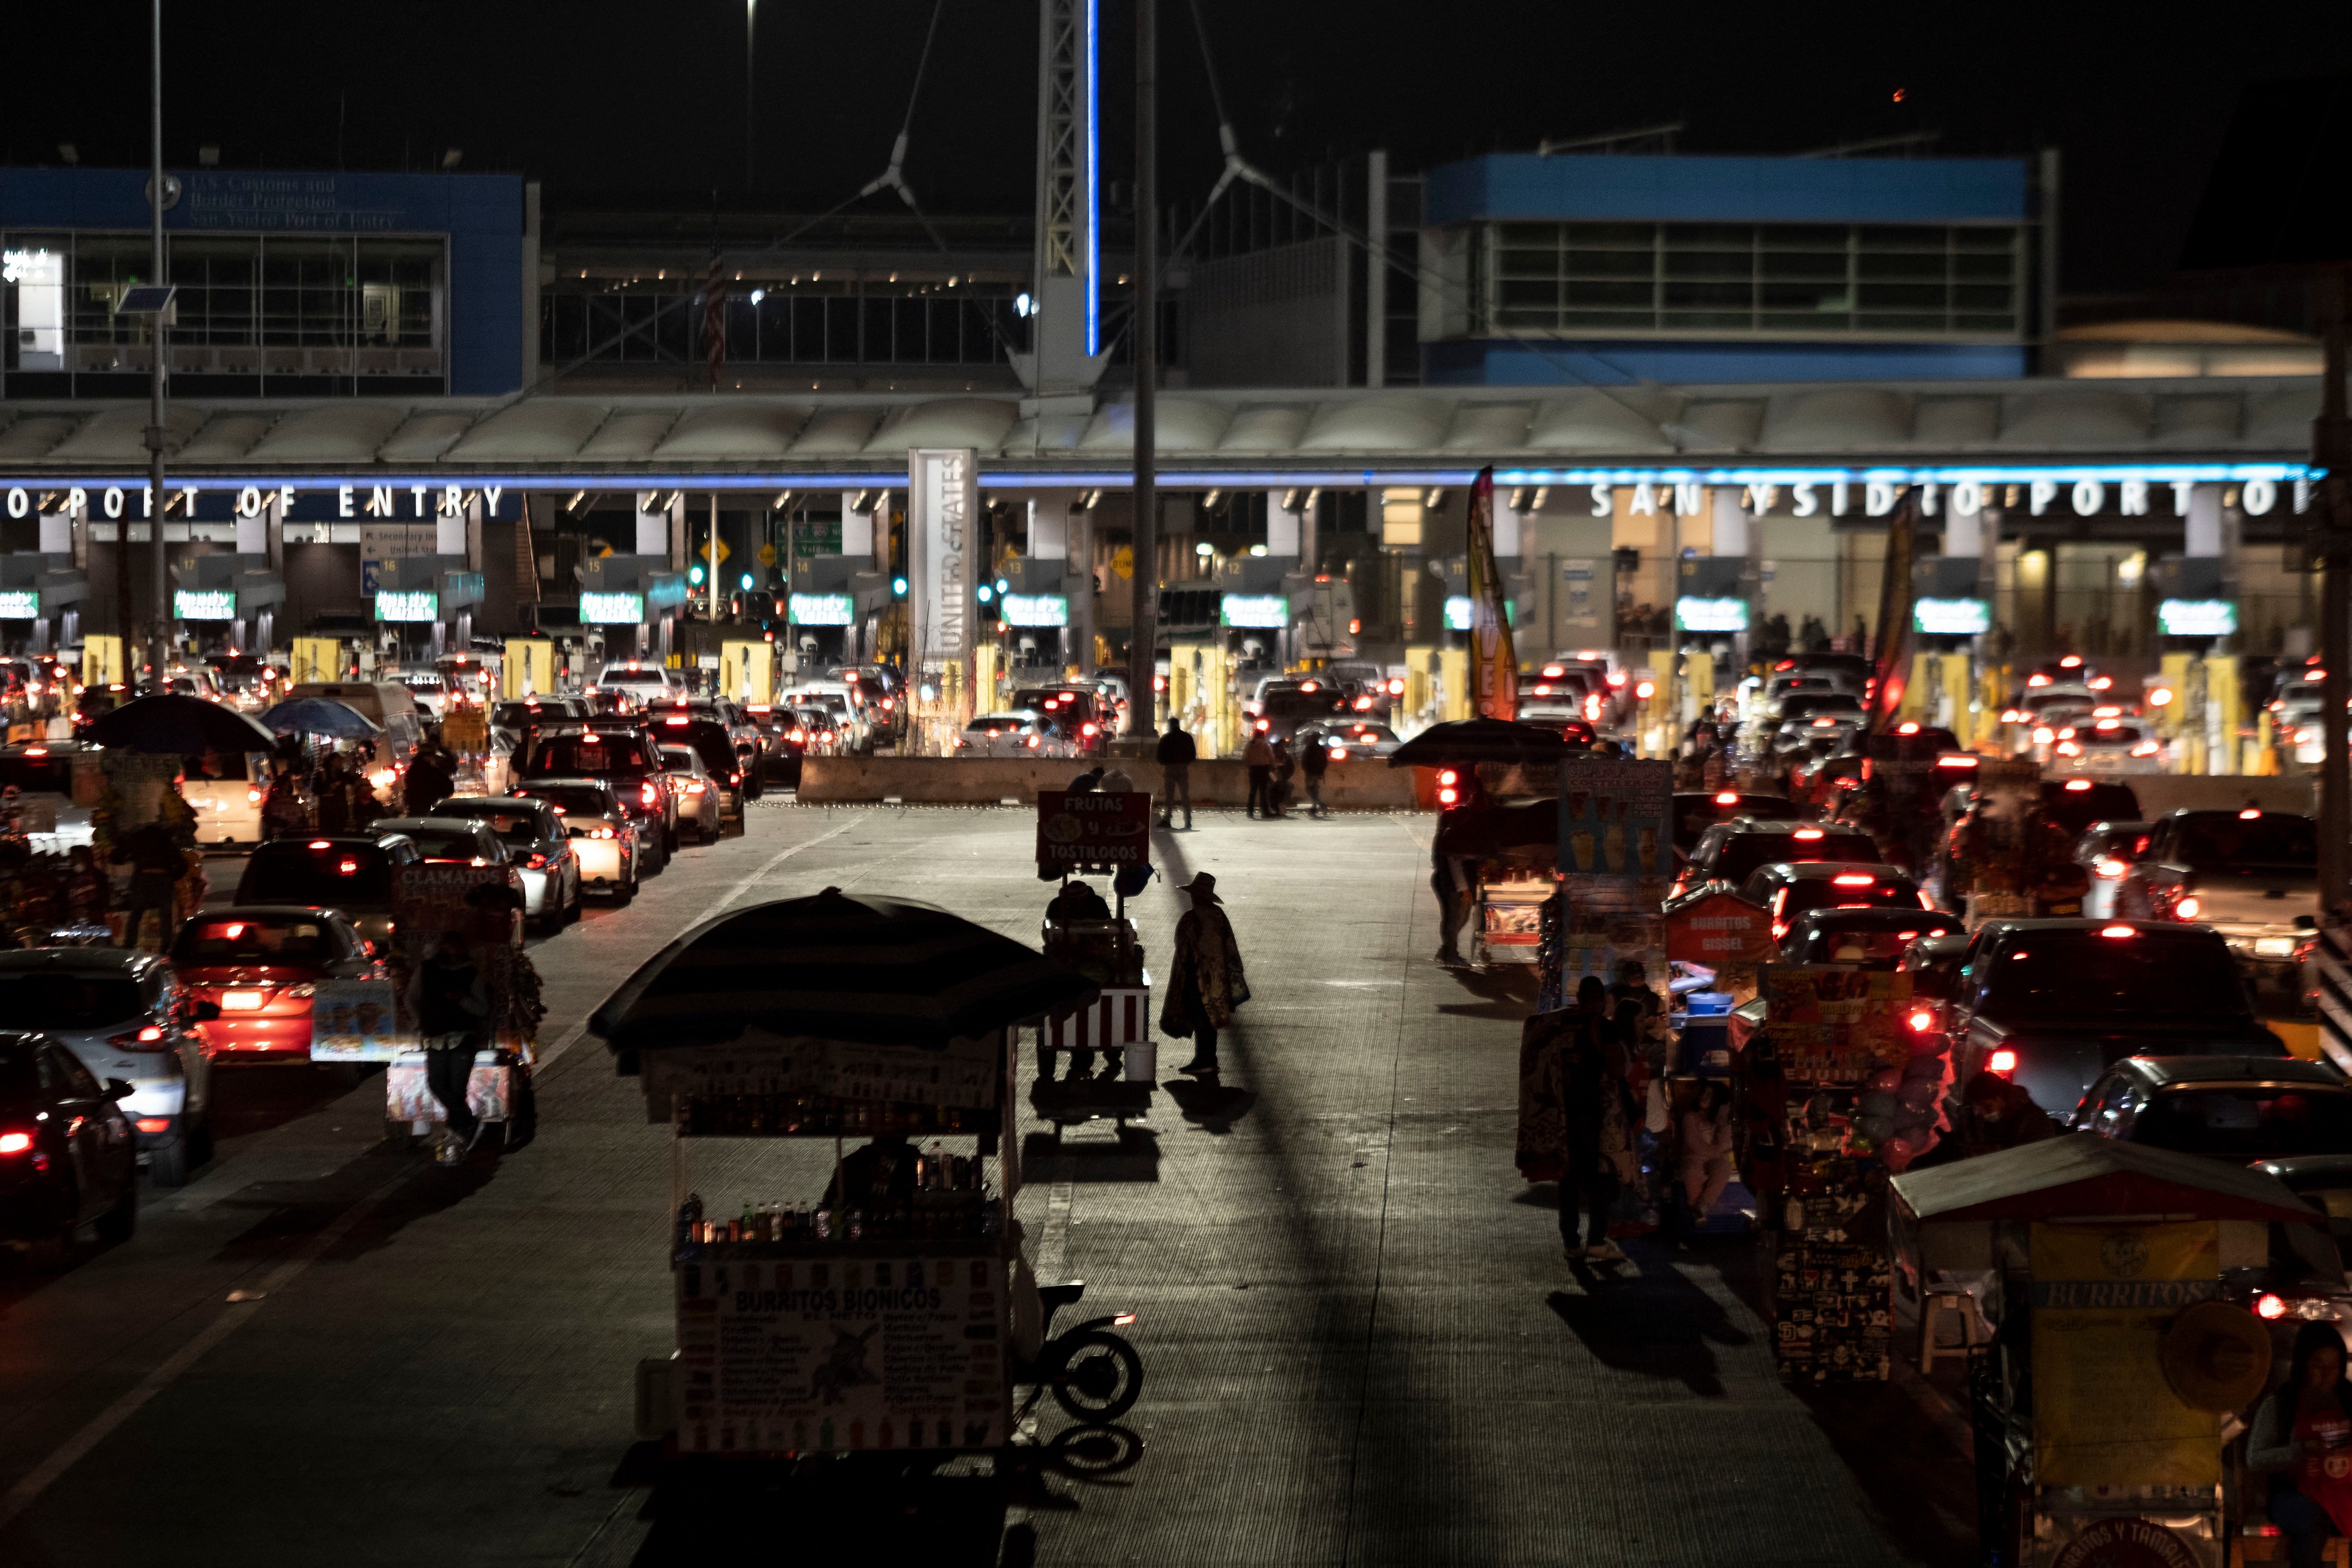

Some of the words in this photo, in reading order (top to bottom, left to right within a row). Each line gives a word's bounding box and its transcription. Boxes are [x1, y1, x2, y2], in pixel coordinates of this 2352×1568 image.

[229, 175, 299, 192] Customs
[305, 176, 335, 193] and
[253, 192, 335, 209] Protection
[285, 213, 317, 228] Port
[349, 213, 396, 230] Entry
[241, 485, 295, 518] OF
[339, 484, 502, 518] ENTRY
[941, 455, 962, 551] STATES
[1591, 482, 1701, 517] SAN
[2030, 479, 2195, 516] PORT
[384, 560, 396, 571] 16
[588, 561, 600, 572] 15
[797, 561, 808, 573] 14
[1009, 562, 1021, 574] 13
[1113, 560, 1132, 569] BUM
[1227, 562, 1241, 575] 12
[1452, 563, 1463, 575] 11
[940, 553, 962, 648] UNITED
[1566, 762, 1665, 779] CLAMATOS
[1064, 796, 1124, 812] FRUTAS
[1048, 844, 1139, 860] TOSTILOCOS
[401, 869, 500, 885] CLAMATOS
[1689, 916, 1751, 930] BURRITOS
[1783, 1068, 1869, 1081] EJUIN
[736, 1290, 838, 1312] BURRITOS
[845, 1287, 941, 1310] BIONICOS
[2047, 1281, 2206, 1307] BURRITOS
[2115, 1521, 2125, 1541] Y
